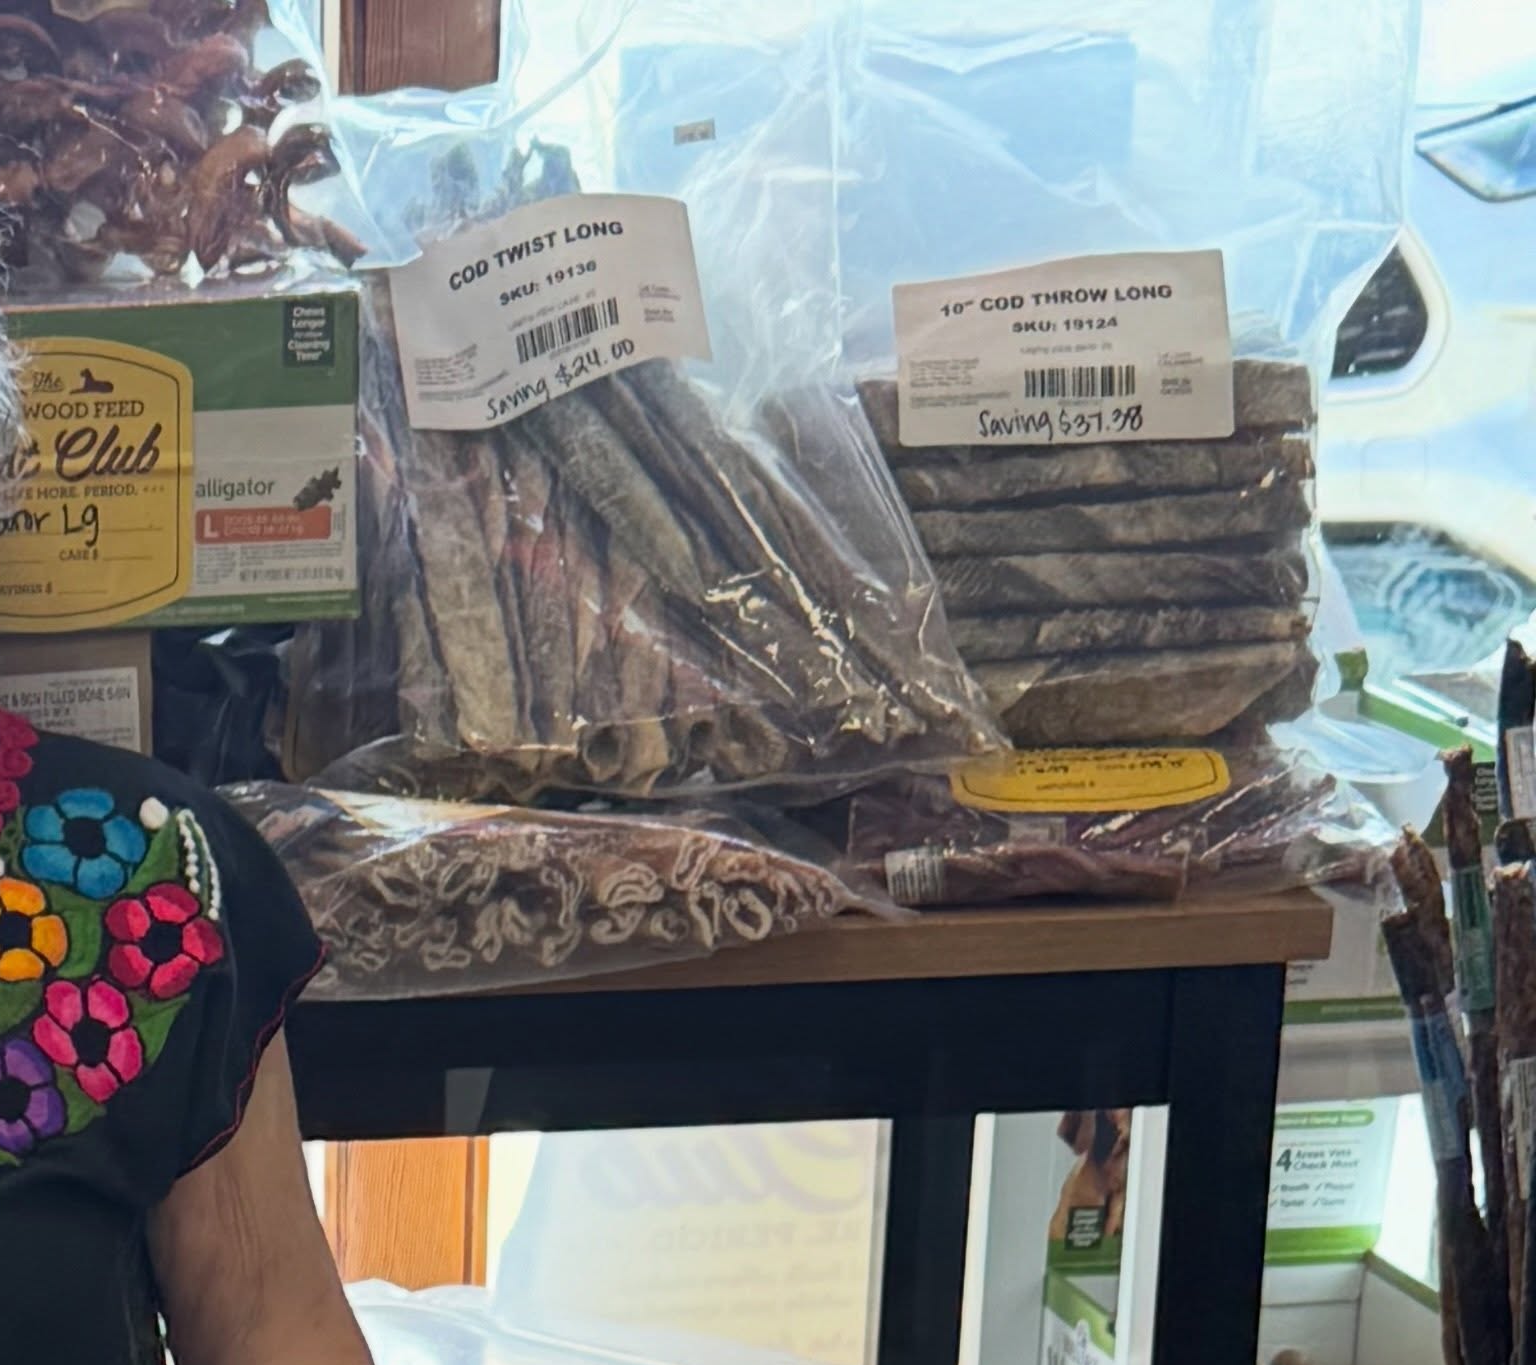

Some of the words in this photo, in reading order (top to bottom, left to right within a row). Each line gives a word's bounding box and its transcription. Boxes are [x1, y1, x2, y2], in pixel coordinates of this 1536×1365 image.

[447, 258, 490, 291] COD
[492, 231, 557, 269] TWIST
[563, 220, 624, 244] LONG
[498, 281, 540, 307] SKU:
[979, 294, 1025, 313] COD
[1031, 288, 1108, 308] THROW
[1114, 284, 1173, 302] LONG
[1011, 319, 1057, 334] SKU:
[31, 371, 64, 394] The
[92, 400, 145, 418] FEED
[485, 375, 551, 421] Saving
[978, 408, 1055, 441] Saving
[54, 422, 163, 483] Club
[194, 477, 276, 501] alligator
[203, 513, 219, 539] L
[1275, 1148, 1293, 1173] 4
